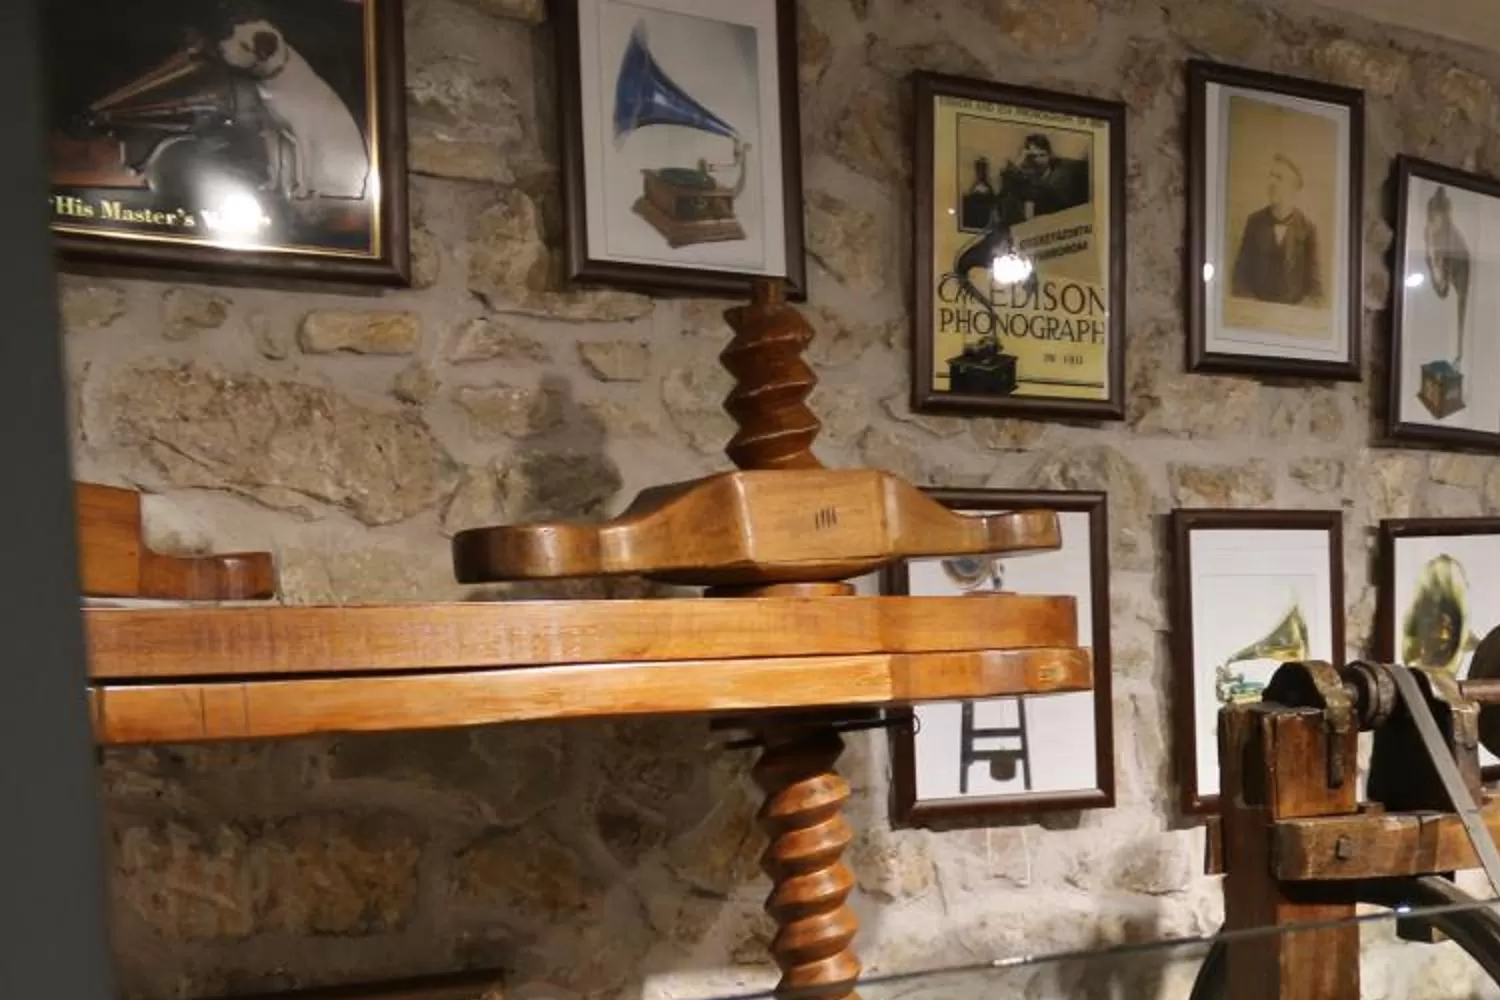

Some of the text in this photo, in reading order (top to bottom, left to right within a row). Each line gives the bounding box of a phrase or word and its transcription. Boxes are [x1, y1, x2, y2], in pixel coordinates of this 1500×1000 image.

[101, 200, 195, 227] Master's
[990, 270, 1105, 316] EDISON
[939, 308, 1105, 345] PHONOGRAPH
